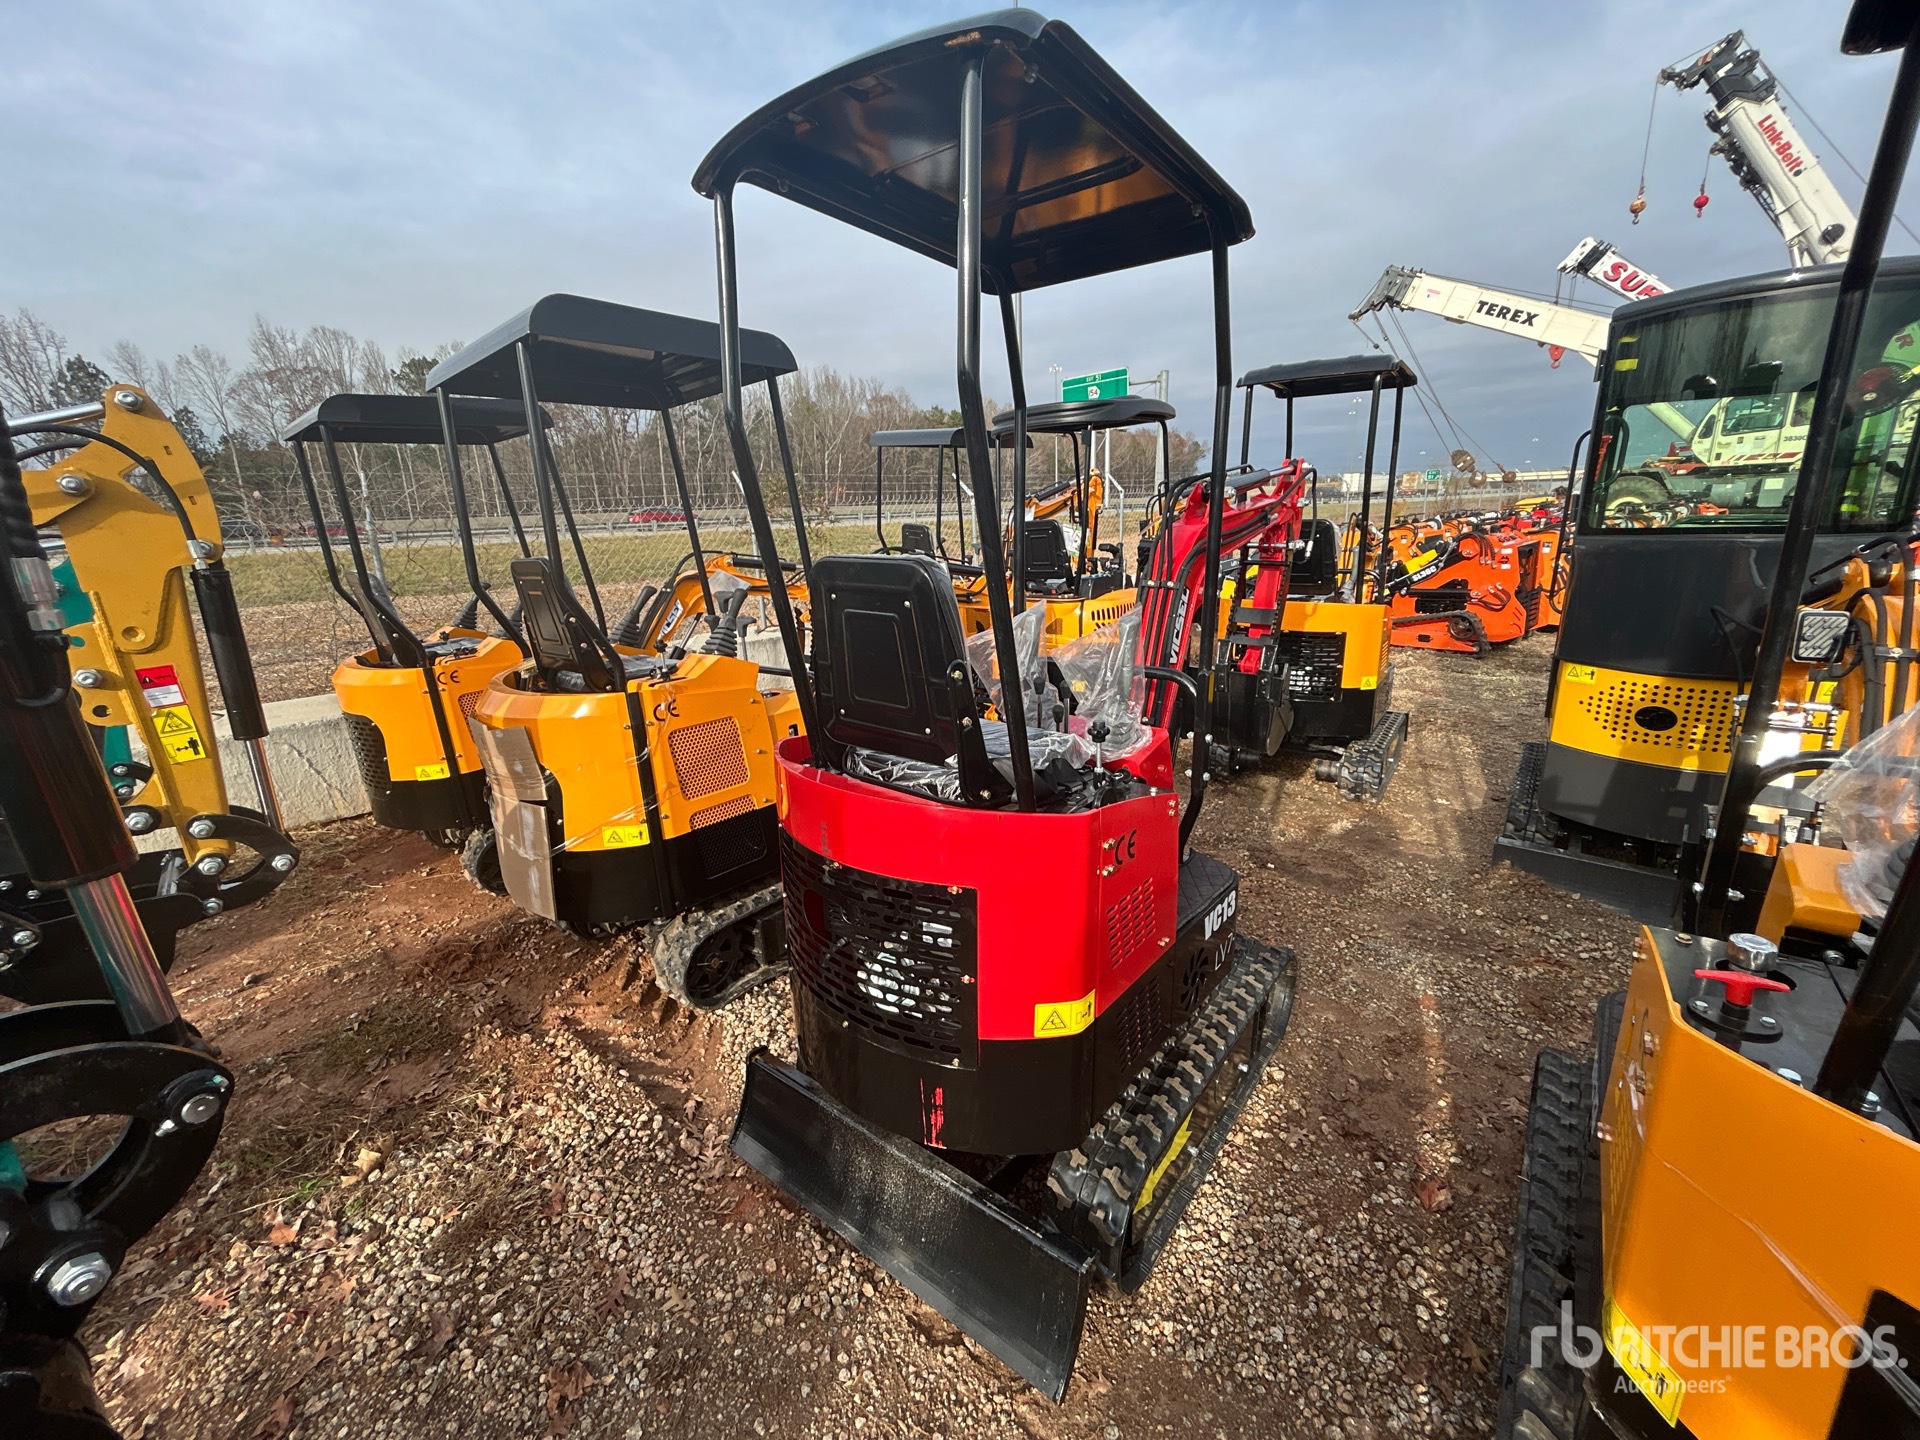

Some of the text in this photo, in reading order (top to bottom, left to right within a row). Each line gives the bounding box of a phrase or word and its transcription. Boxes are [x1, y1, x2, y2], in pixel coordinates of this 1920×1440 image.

[1476, 300, 1540, 327] TEREX
[1169, 587, 1190, 664] VICSEL
[1204, 890, 1237, 940] VC13
